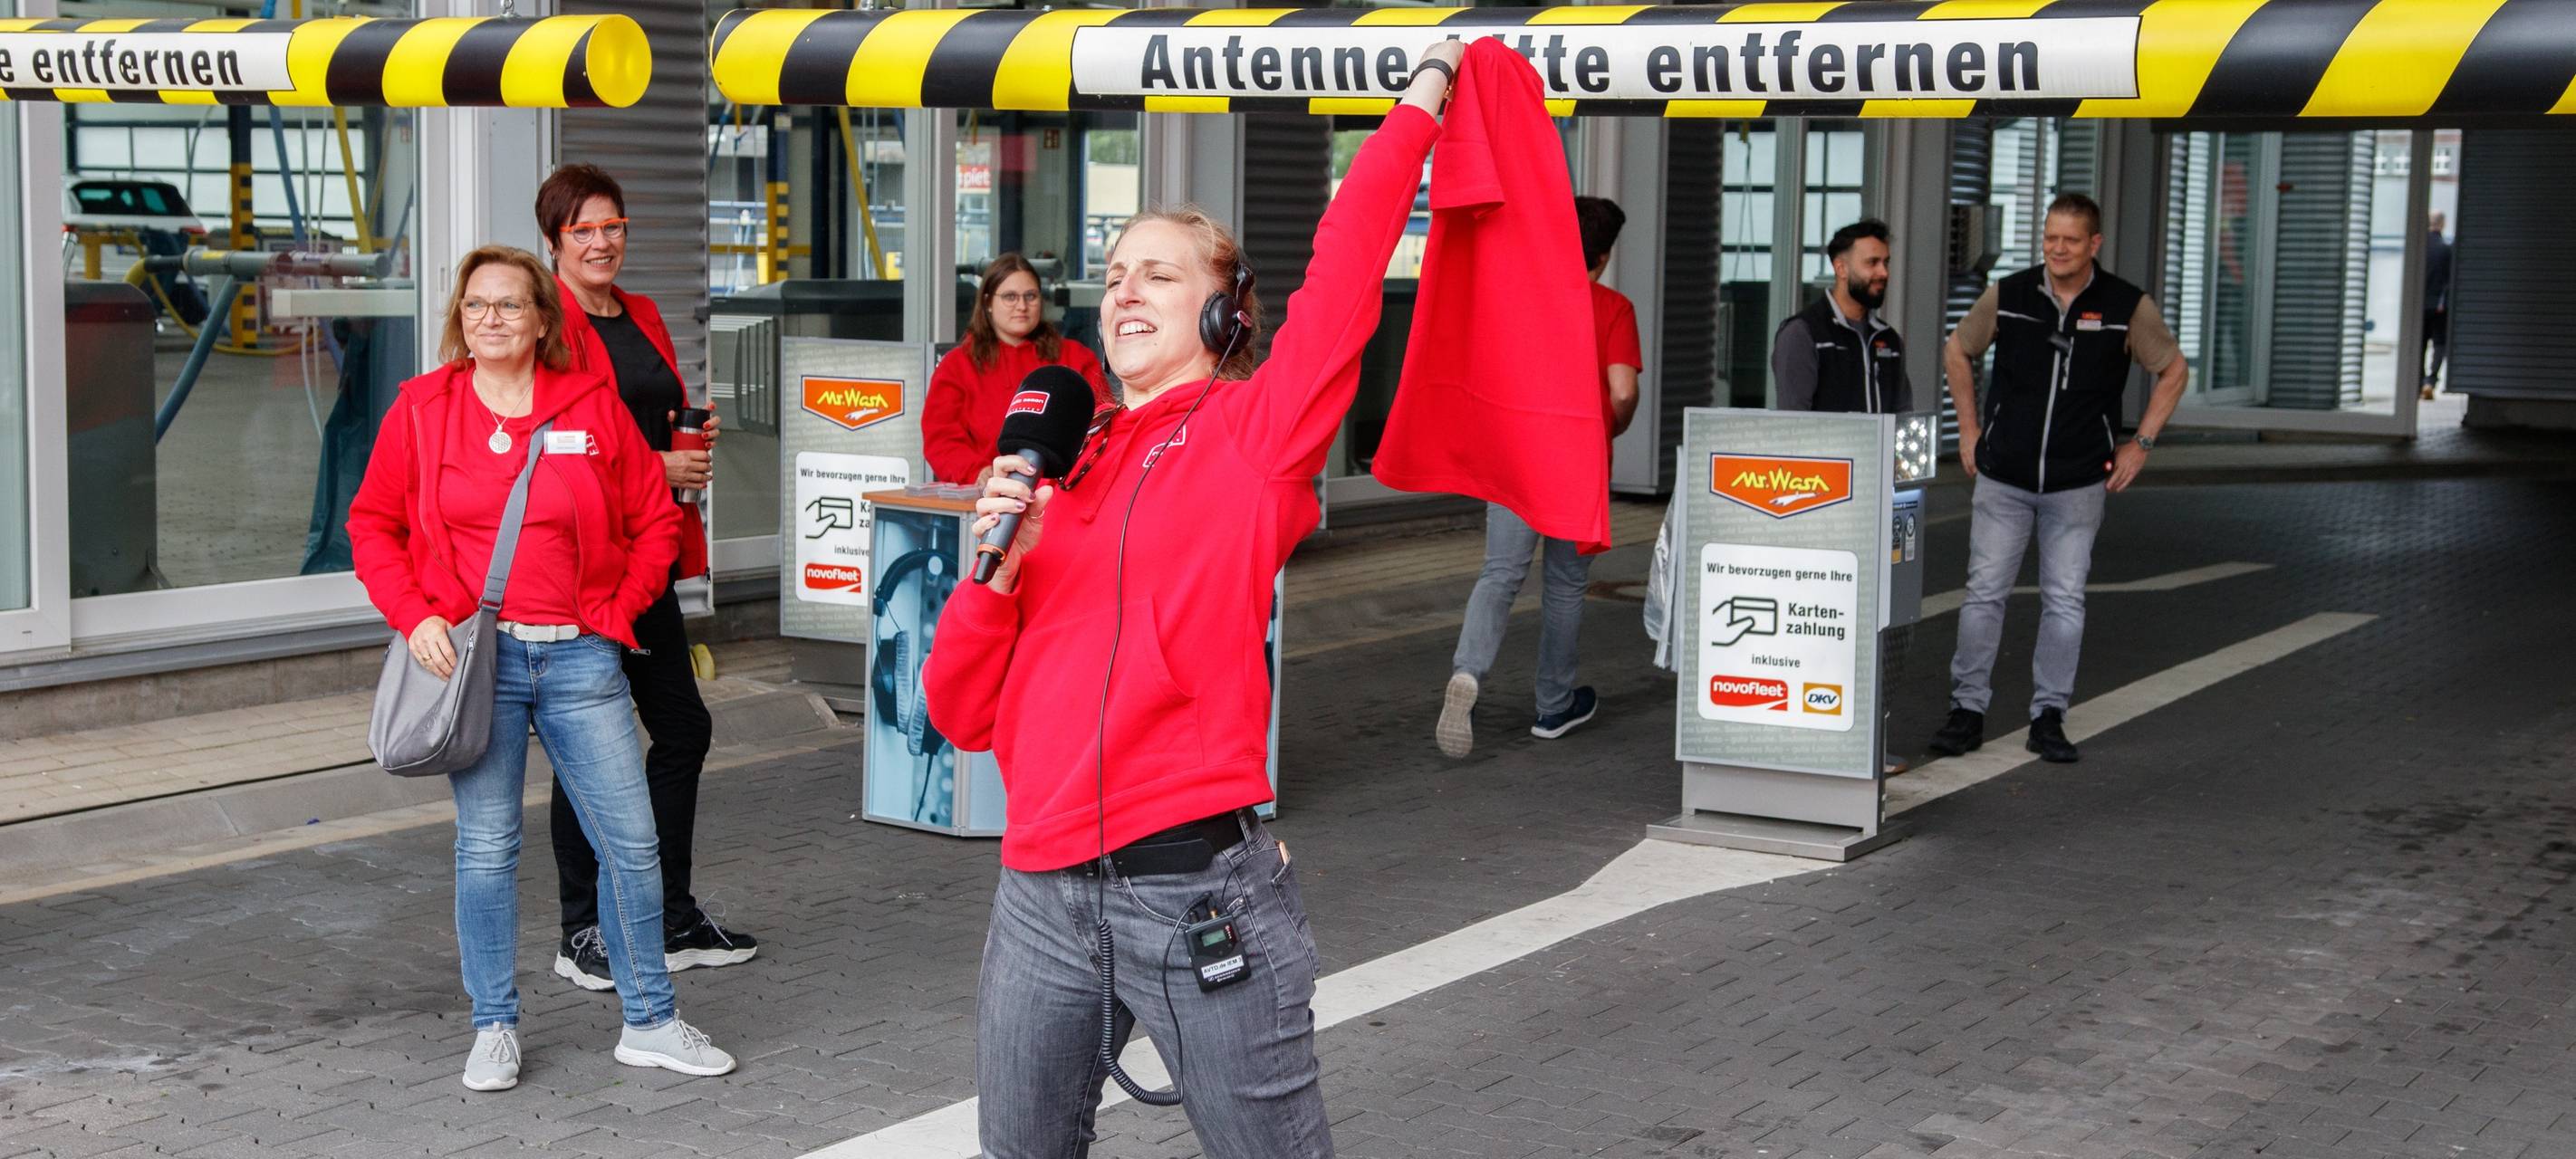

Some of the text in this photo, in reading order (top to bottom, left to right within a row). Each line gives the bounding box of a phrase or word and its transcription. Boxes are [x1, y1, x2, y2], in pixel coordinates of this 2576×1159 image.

[33, 38, 244, 86] entfernen
[1140, 34, 1410, 91] Antenne
[1647, 30, 2041, 92] entfernen
[800, 468, 906, 484] Wir bevorzugen gerne Ihre
[834, 544, 870, 557] inklusive
[806, 567, 859, 581] novofleet
[1706, 561, 1853, 582] Wir bevorzugen gerne Ihre
[1788, 602, 1844, 619] Karten-
[1786, 622, 1845, 640] zahlung
[1752, 653, 1801, 668] inklusive
[1713, 680, 1838, 704] novofleet DKV
